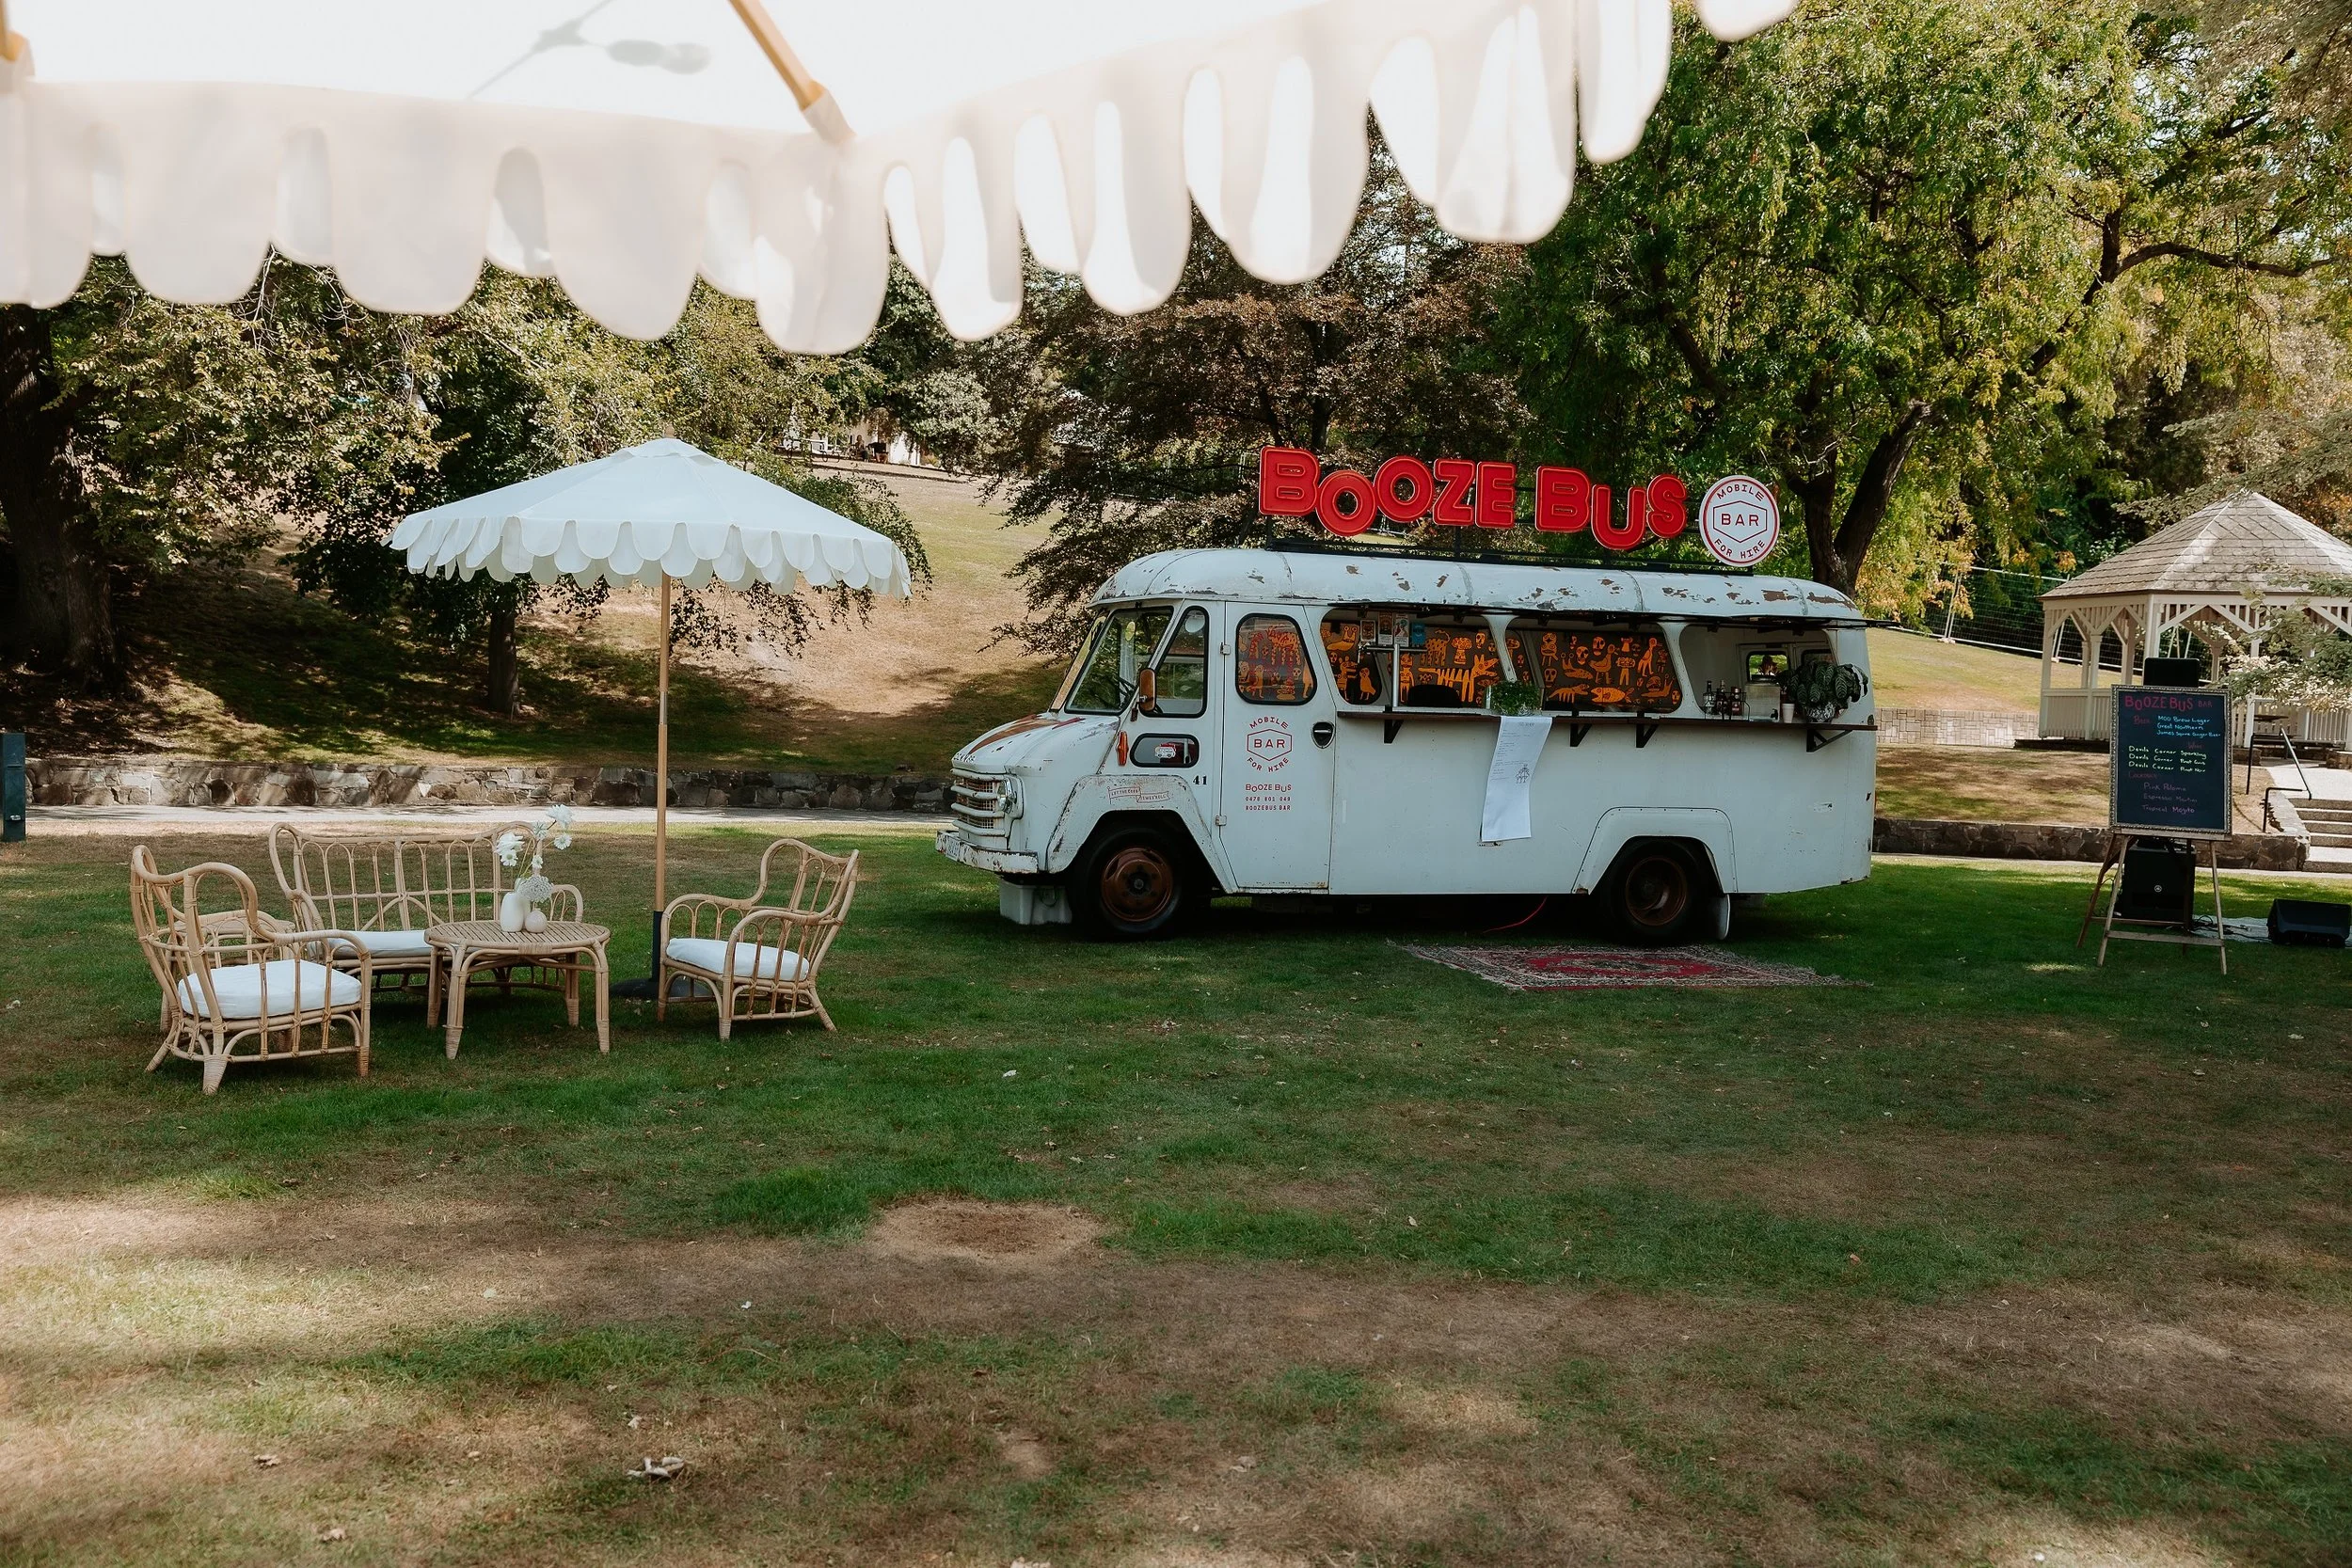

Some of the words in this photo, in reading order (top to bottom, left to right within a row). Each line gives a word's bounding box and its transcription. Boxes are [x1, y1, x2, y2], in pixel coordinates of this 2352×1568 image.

[1259, 446, 1517, 537] BOOZE
[1534, 465, 1688, 550] BUS
[1716, 483, 1765, 501] MOBILE
[1721, 513, 1759, 526] BAR
[1714, 538, 1733, 557] FOR
[1740, 540, 1766, 559] HIRE
[2125, 695, 2168, 711] BOOZE
[2170, 696, 2194, 712] BUS
[2199, 700, 2213, 708] BAR
[1249, 716, 1289, 729] MOBILE
[2191, 717, 2210, 725] Lager
[1254, 738, 1285, 748] BAR
[2181, 750, 2207, 760] Sparkling
[1247, 757, 1262, 770] FOR
[1268, 757, 1289, 772] HIRE
[1192, 775, 1207, 785] 41
[2144, 782, 2160, 791] Pink
[1245, 784, 1273, 793] BOOZE
[1275, 784, 1292, 793] BUS
